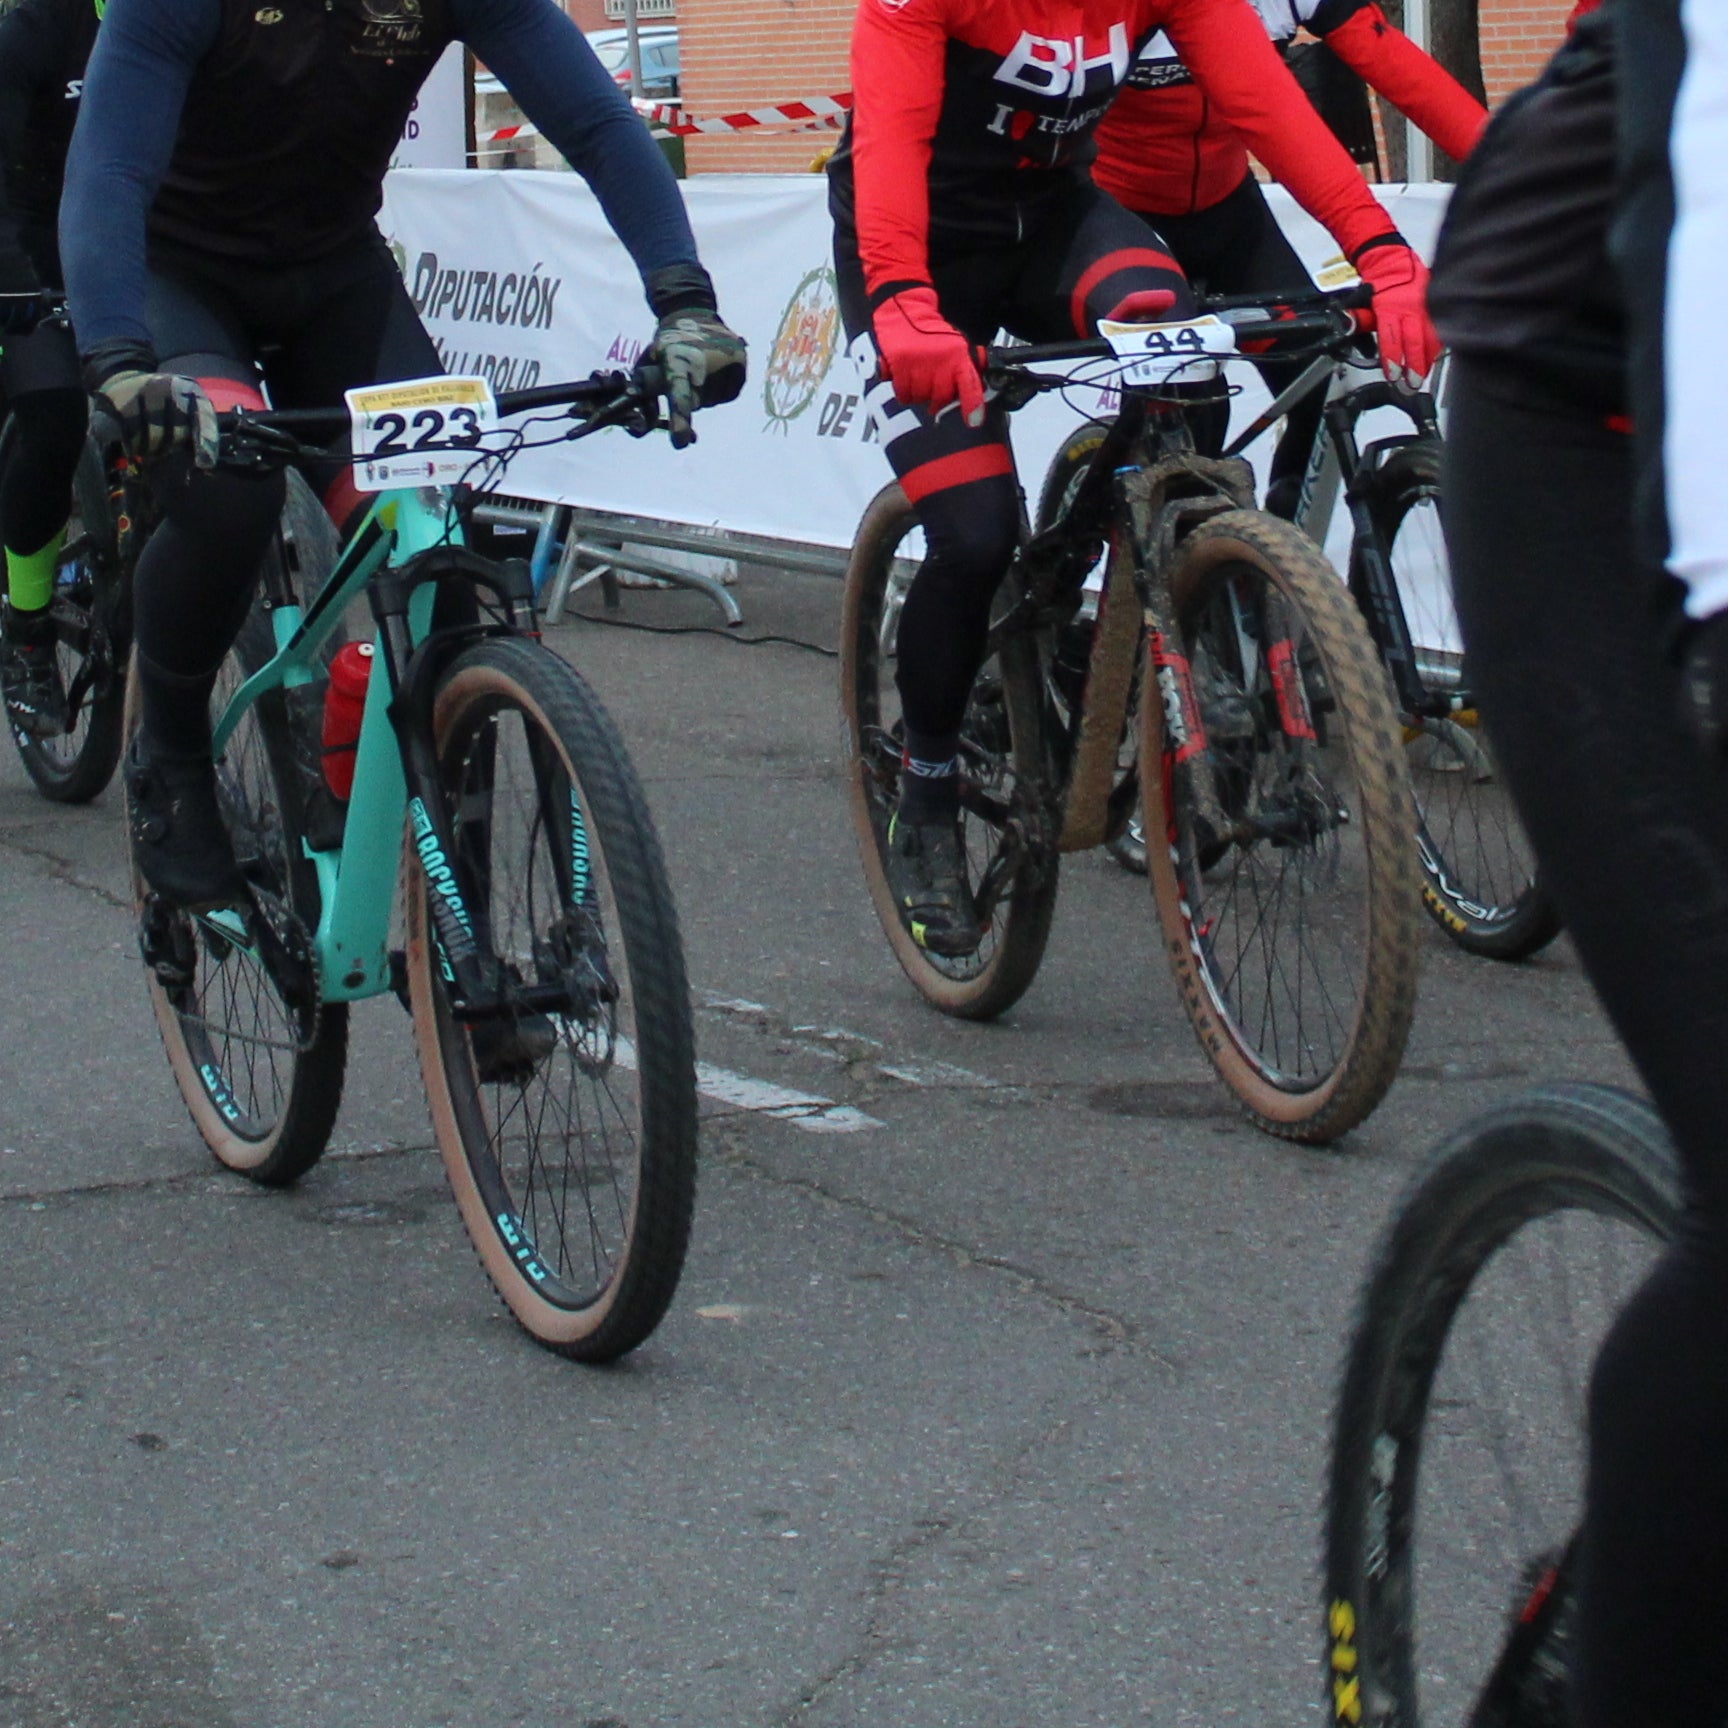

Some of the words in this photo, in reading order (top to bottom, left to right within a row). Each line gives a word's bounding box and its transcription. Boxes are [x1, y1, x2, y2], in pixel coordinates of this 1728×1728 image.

[992, 20, 1130, 99] BH
[411, 251, 562, 330] DIPUTACIÓN
[1145, 327, 1205, 354] 44
[372, 406, 483, 454] 223
[817, 391, 859, 438] DE
